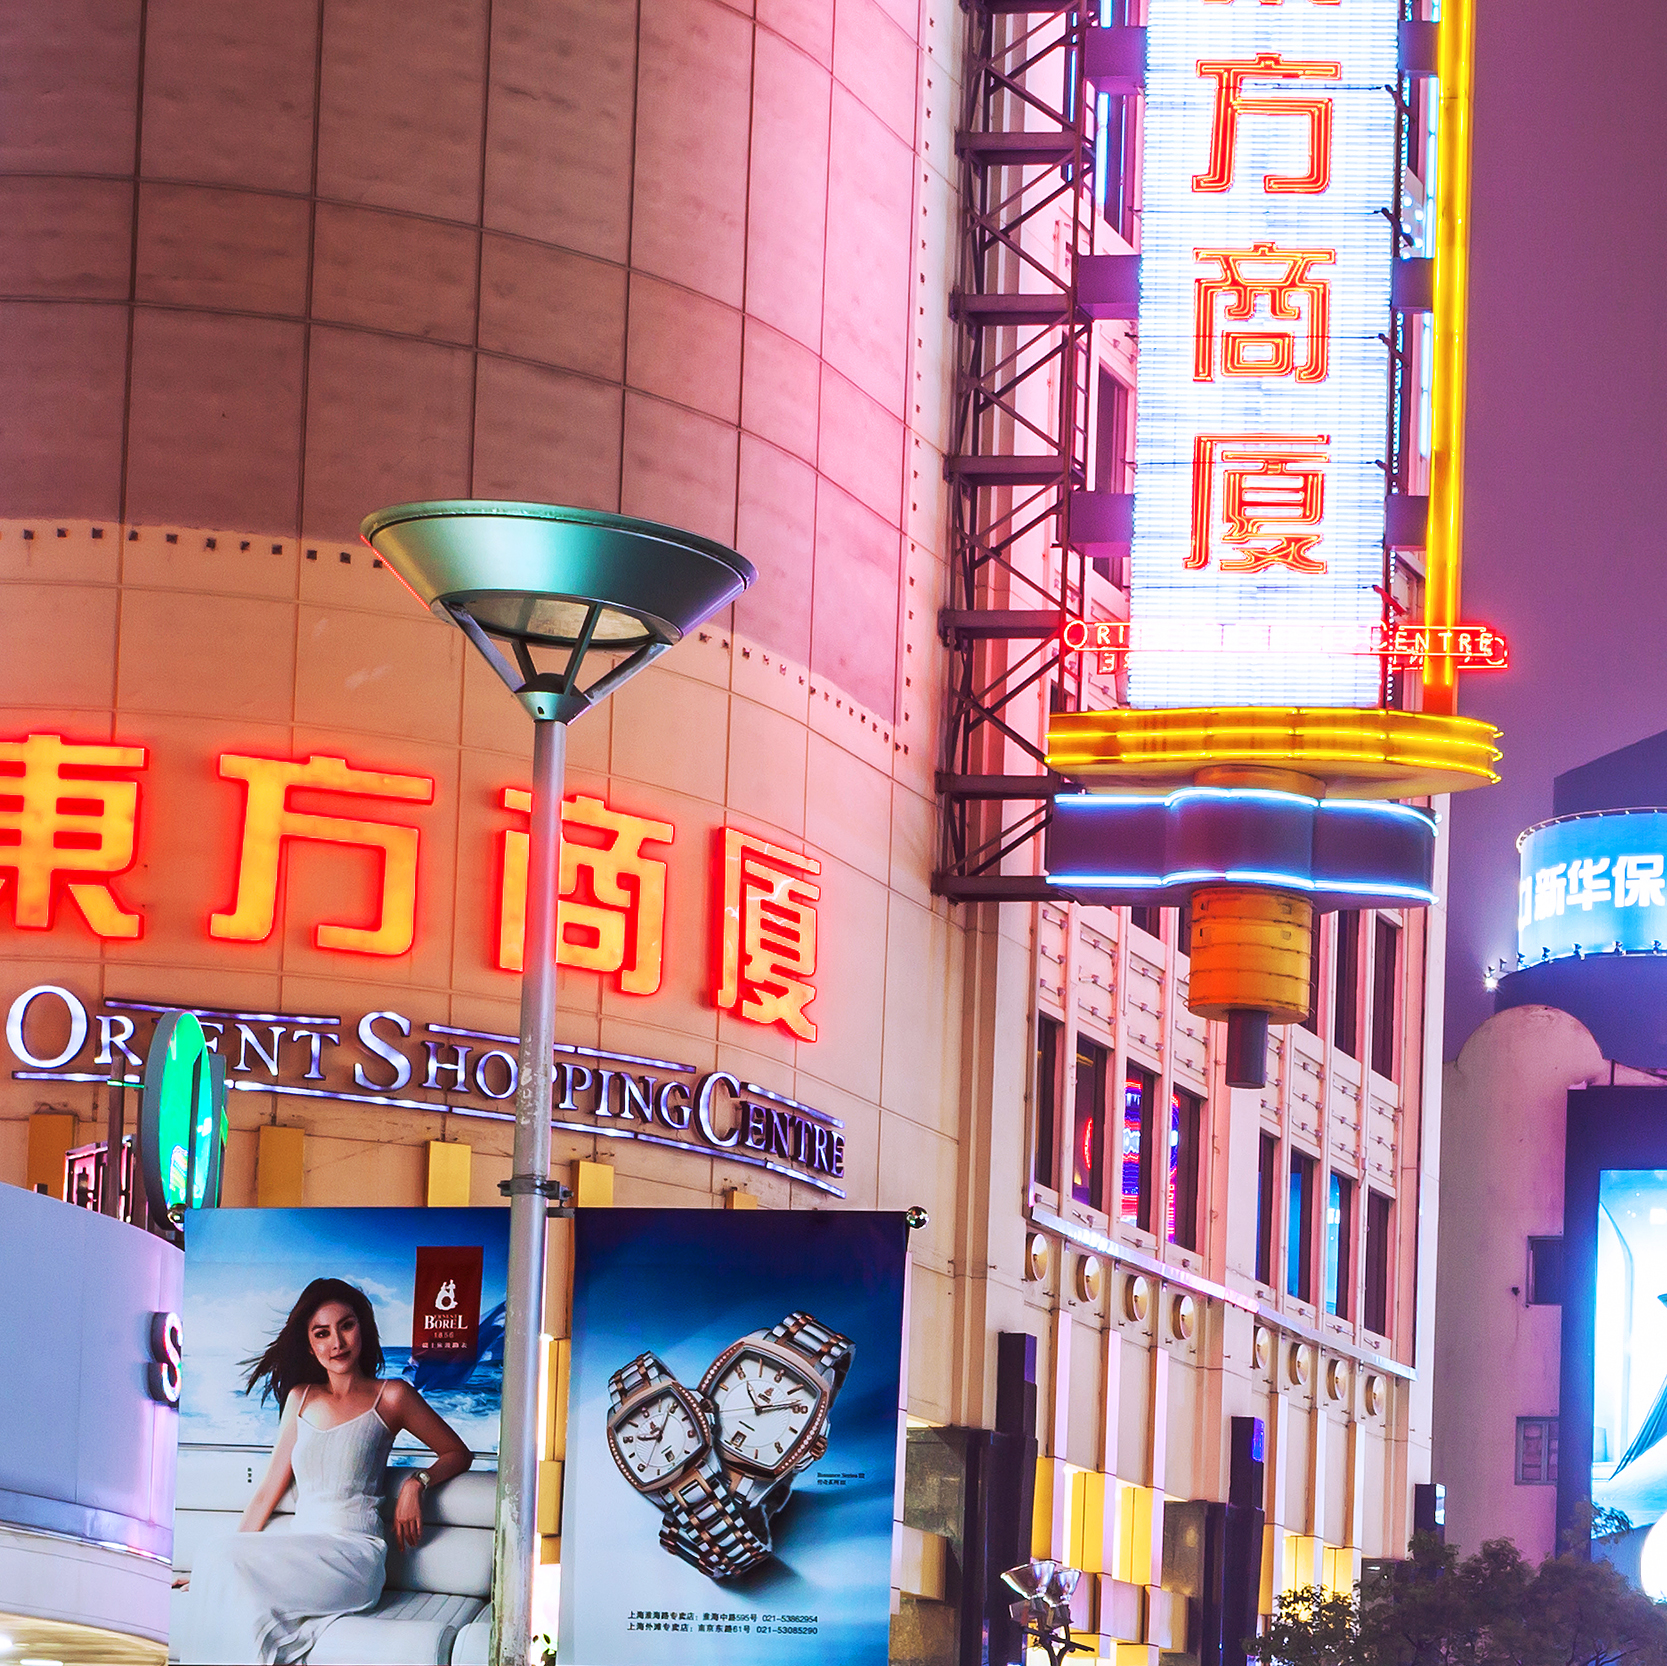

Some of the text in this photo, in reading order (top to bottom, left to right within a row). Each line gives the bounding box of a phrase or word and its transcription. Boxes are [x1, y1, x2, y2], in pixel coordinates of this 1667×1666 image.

[1183, 0, 1341, 574] 方商厦
[0, 735, 821, 1042] 東方商厦
[5, 985, 846, 1178] ORENT SHOPING CENTRE
[424, 1315, 468, 1330] BOREL
